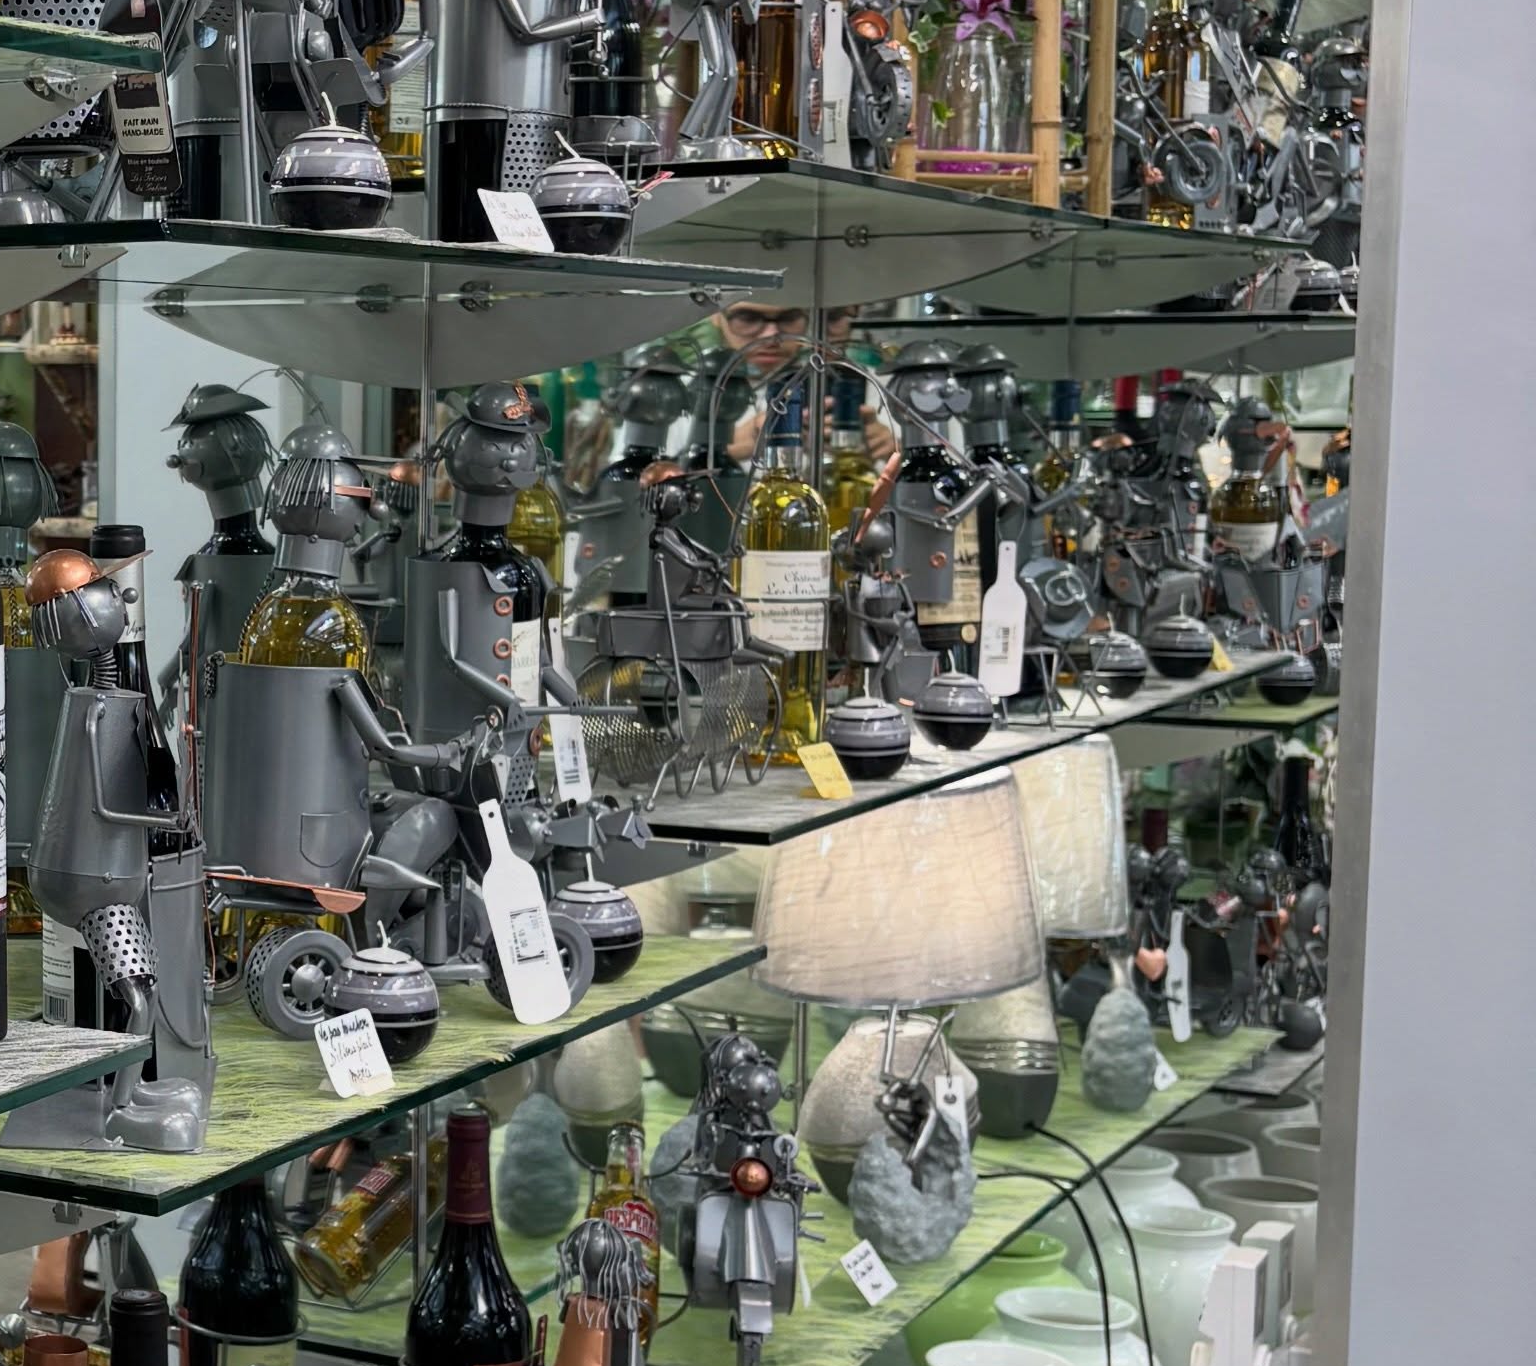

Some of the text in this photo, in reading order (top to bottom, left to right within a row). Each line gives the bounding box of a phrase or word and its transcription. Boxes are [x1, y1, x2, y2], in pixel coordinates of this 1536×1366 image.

[123, 117, 160, 128] FAIT MAIN
[121, 127, 165, 137] HAND-MADE
